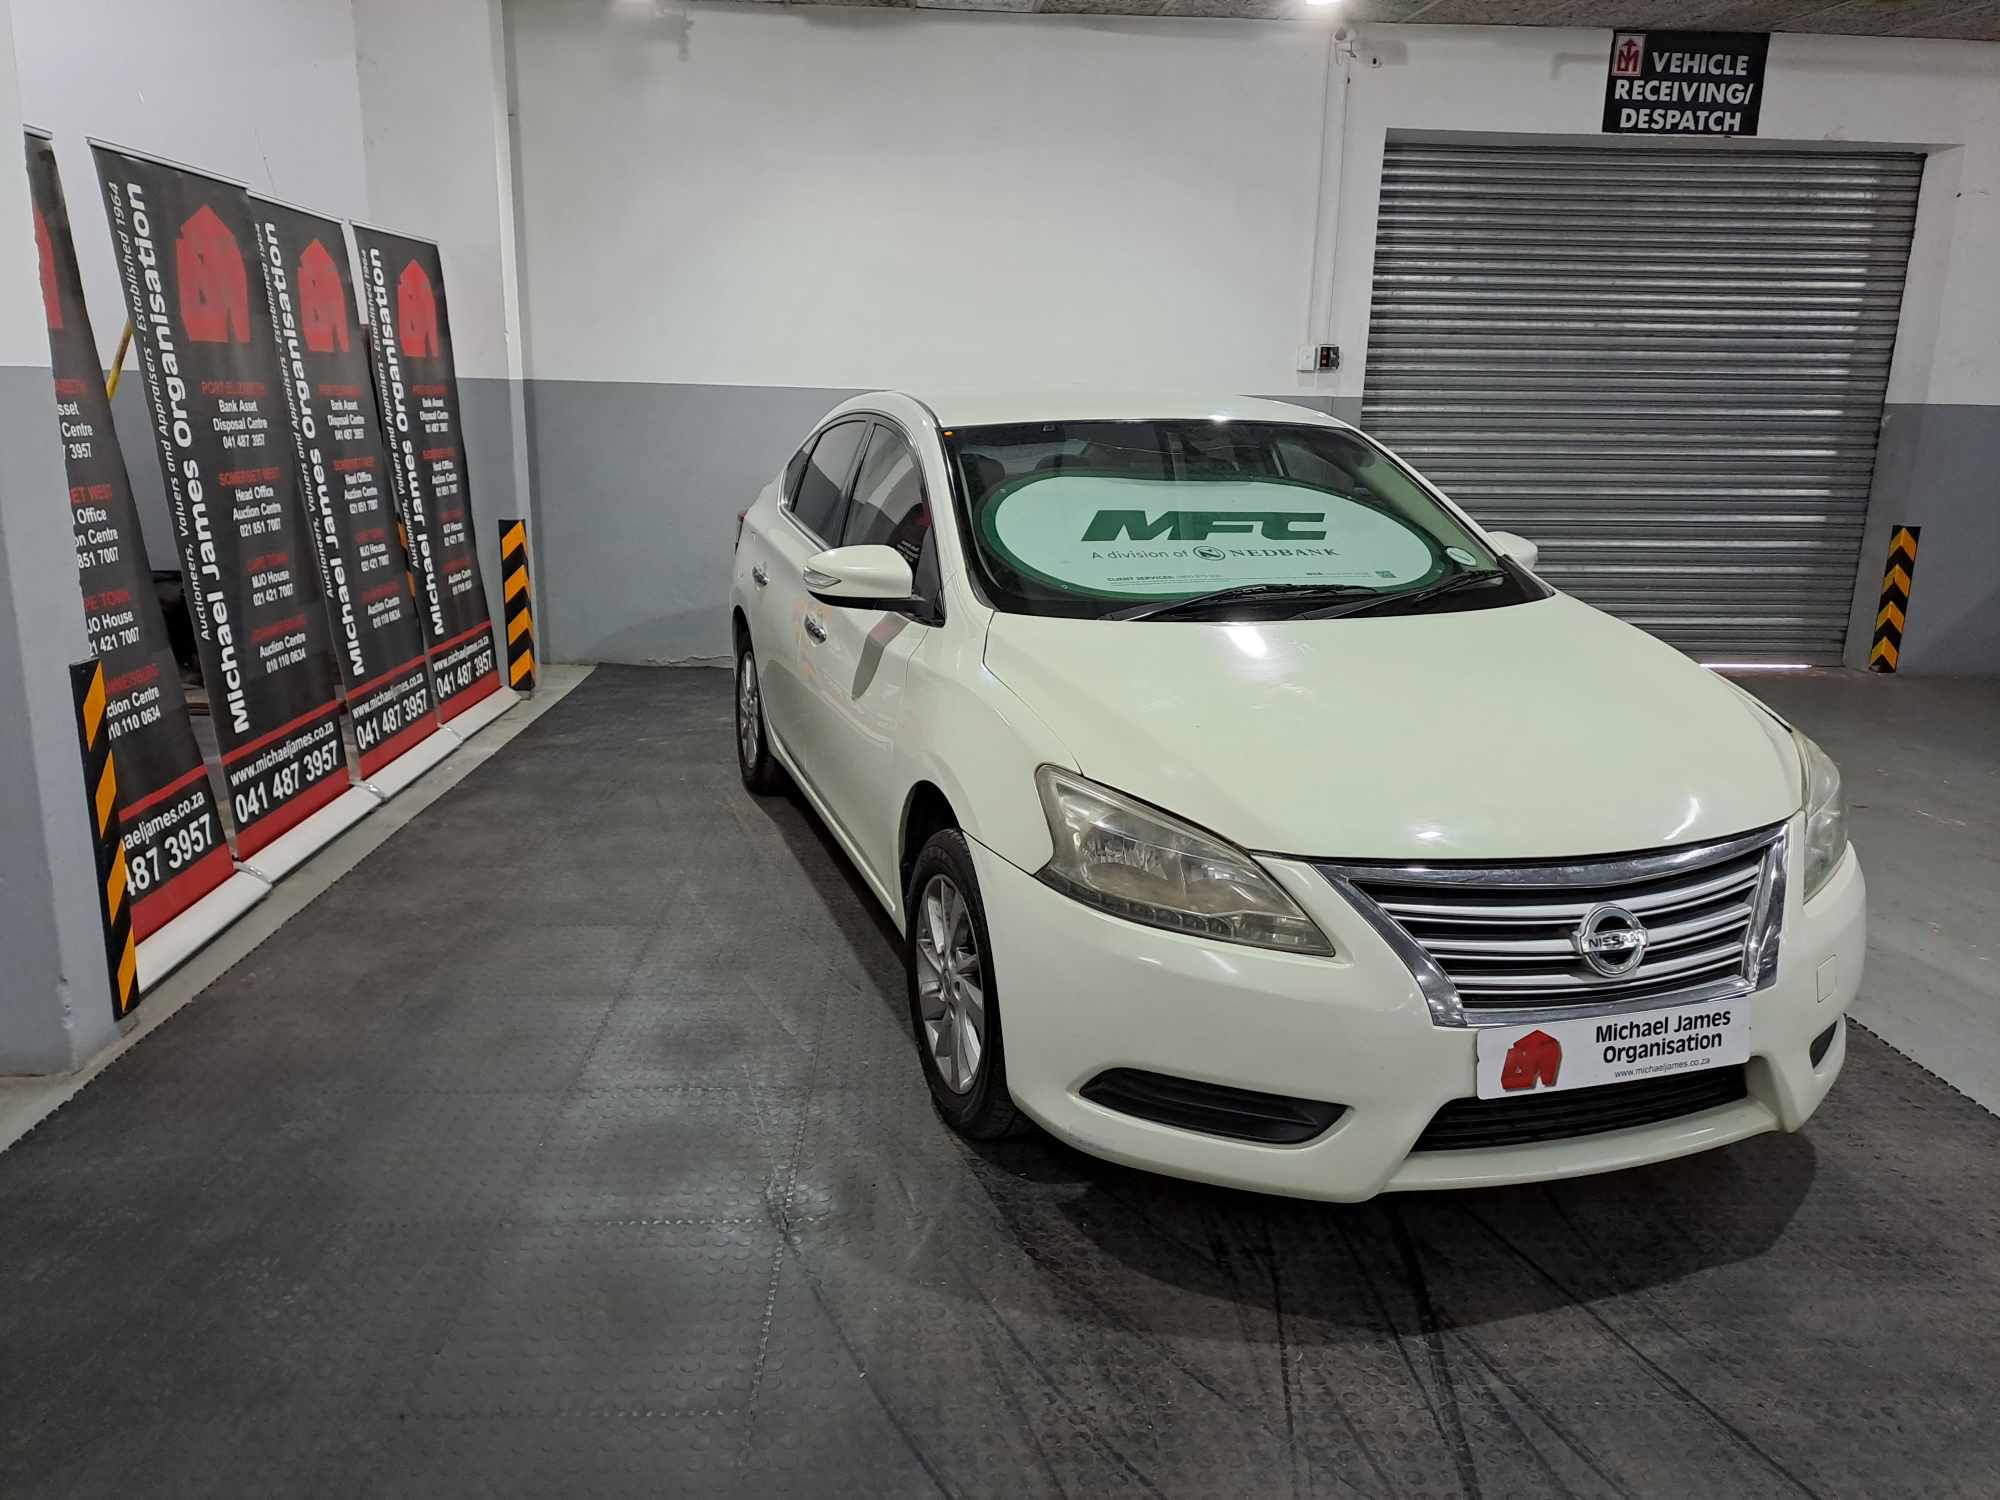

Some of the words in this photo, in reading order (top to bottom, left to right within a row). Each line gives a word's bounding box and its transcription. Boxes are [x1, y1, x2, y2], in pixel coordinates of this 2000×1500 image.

[1652, 52, 1749, 76] VEHICLE
[1614, 79, 1754, 105] RECEIVING/
[1619, 107, 1742, 132] DESPATCH
[108, 181, 126, 226] 1964
[117, 230, 148, 332] Established
[127, 182, 192, 448] Organisation
[264, 222, 317, 440] Organisation
[369, 248, 409, 433] Organisation
[143, 346, 169, 437] Appraisers
[61, 422, 94, 438] Centre
[69, 443, 92, 459] 3957
[161, 440, 176, 473] and
[235, 486, 254, 501] Head
[309, 448, 340, 550] James
[402, 439, 426, 527] James
[76, 507, 107, 525] Office
[170, 476, 189, 537] Valuers
[183, 459, 220, 581] James
[233, 504, 260, 520] Auction
[87, 527, 119, 545] Centre
[1081, 510, 1327, 541] MFC
[77, 552, 95, 569] 851
[99, 546, 119, 565] 7007
[1092, 551, 1104, 560] A
[1106, 550, 1170, 560] division
[1174, 549, 1190, 558] of
[1231, 549, 1341, 557] NEDBANK
[185, 543, 211, 641] Auctioneers,
[416, 533, 446, 637] Michael
[101, 610, 134, 630] House
[329, 557, 366, 677] Michael
[99, 633, 118, 652] 421
[119, 626, 140, 646] 7007
[206, 590, 251, 735] Michael
[436, 671, 455, 699] 041
[457, 662, 473, 689] 487
[474, 650, 492, 677] 3957
[131, 685, 160, 708] Centre
[121, 713, 140, 732] 110
[141, 704, 161, 725] 0634
[356, 717, 380, 750] 041
[382, 704, 403, 733] 487
[402, 688, 428, 721] 3957
[230, 720, 335, 787] www.michaeljames.co.za
[235, 781, 268, 823] 041
[272, 761, 300, 799] 487
[303, 740, 338, 782] 3957
[165, 812, 213, 870] 3957
[1588, 930, 1641, 947] NISSAN
[1595, 1016, 1669, 1044] Michael
[1673, 1008, 1731, 1033] James
[1603, 1031, 1723, 1065] Organisation
[1614, 1056, 1711, 1079] www.michaeljames.co.za
